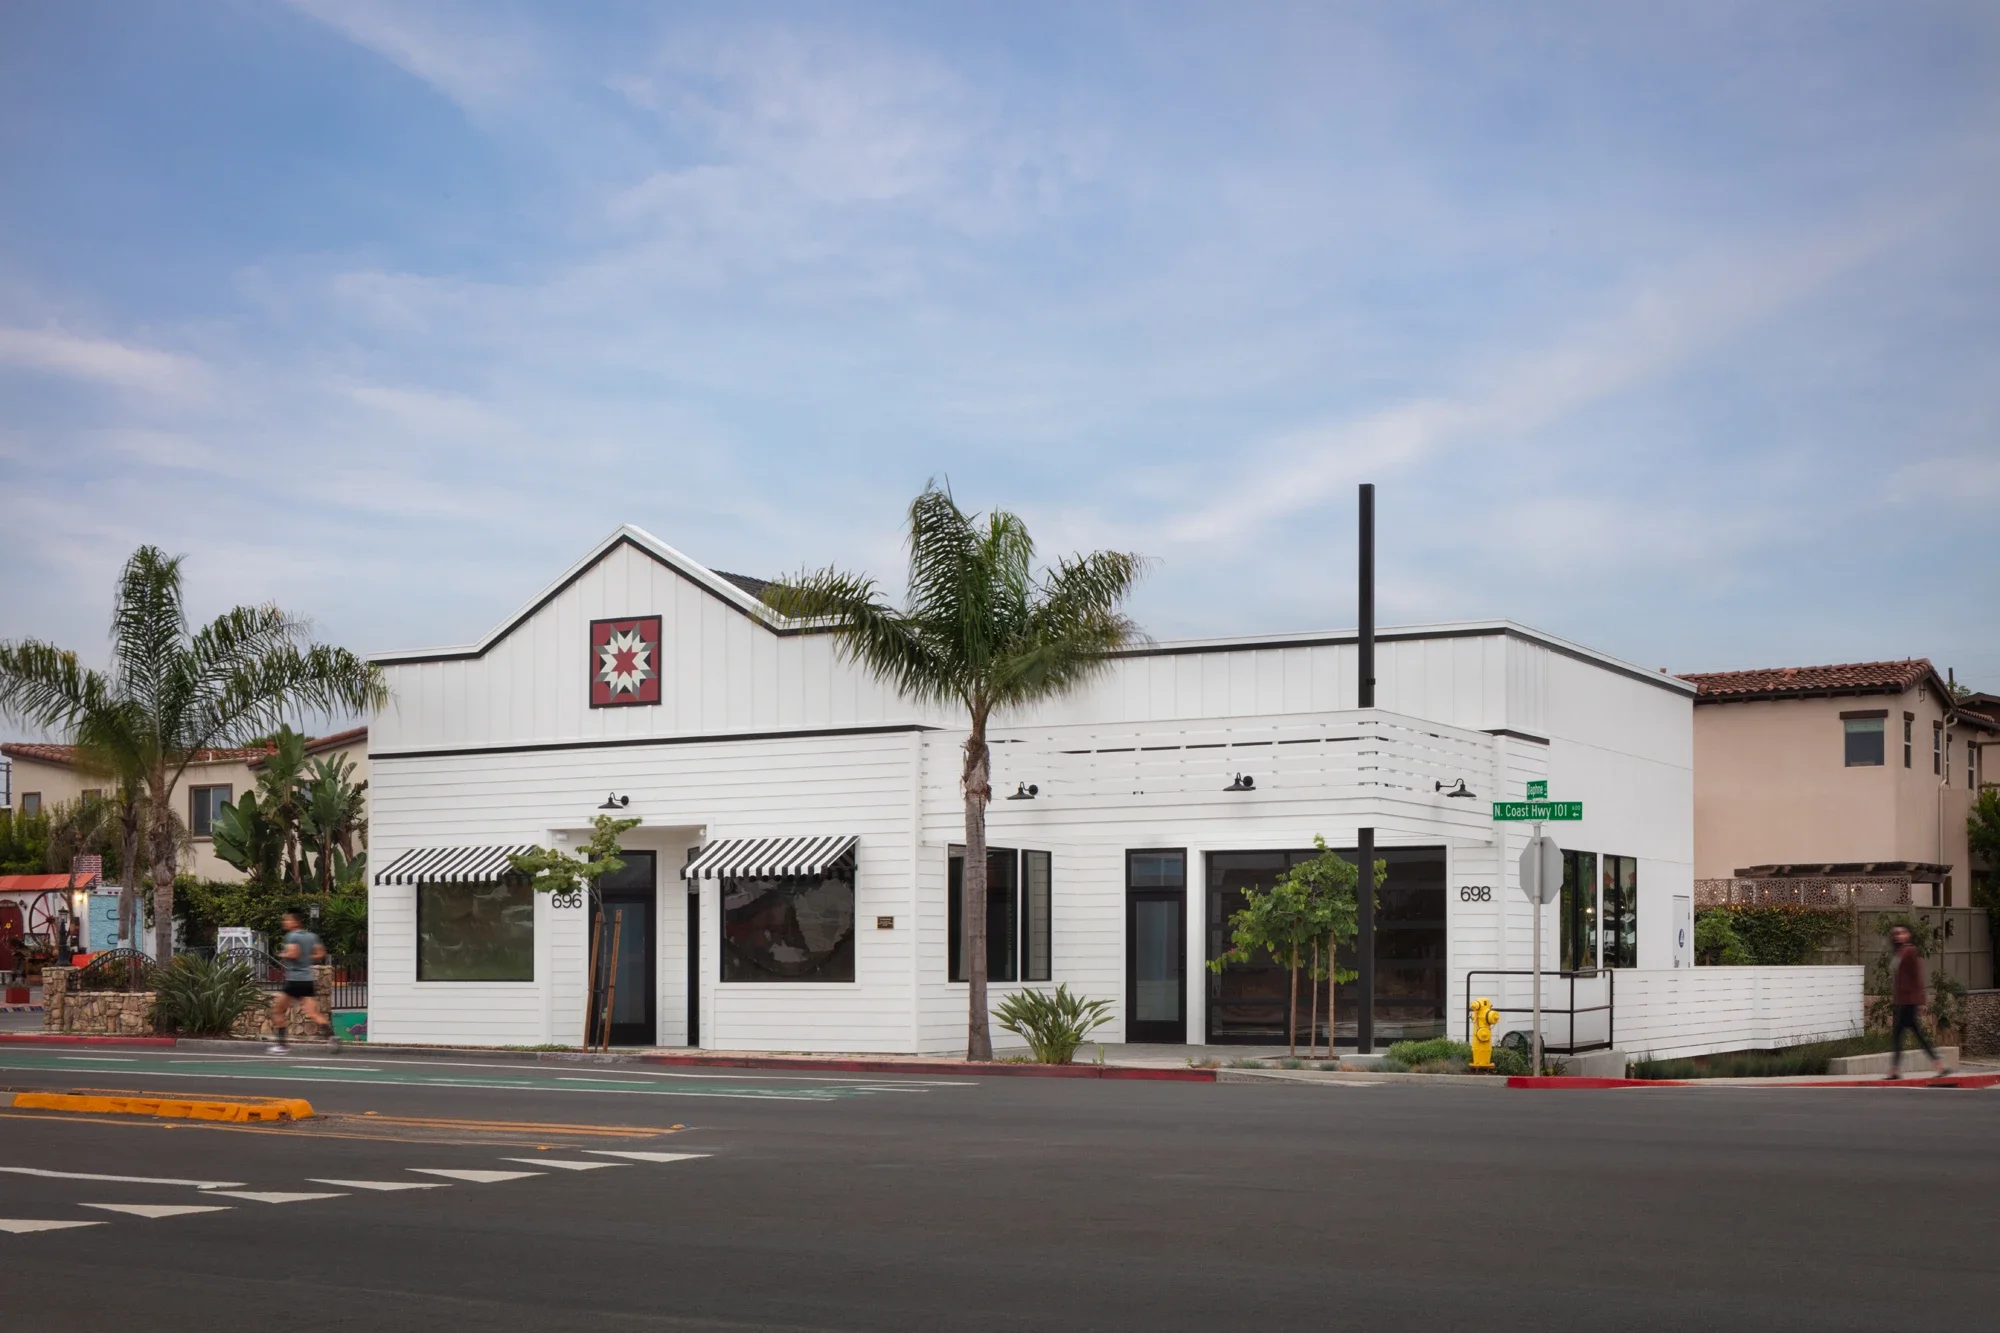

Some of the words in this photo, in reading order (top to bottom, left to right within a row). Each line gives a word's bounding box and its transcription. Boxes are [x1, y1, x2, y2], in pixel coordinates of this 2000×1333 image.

[1527, 784, 1543, 797] Daphne
[1494, 804, 1503, 817] N.
[1505, 804, 1529, 817] Coast
[1532, 804, 1551, 819] Hwy
[1554, 804, 1568, 817] 101
[552, 893, 582, 908] 696
[1460, 885, 1491, 902] 698
